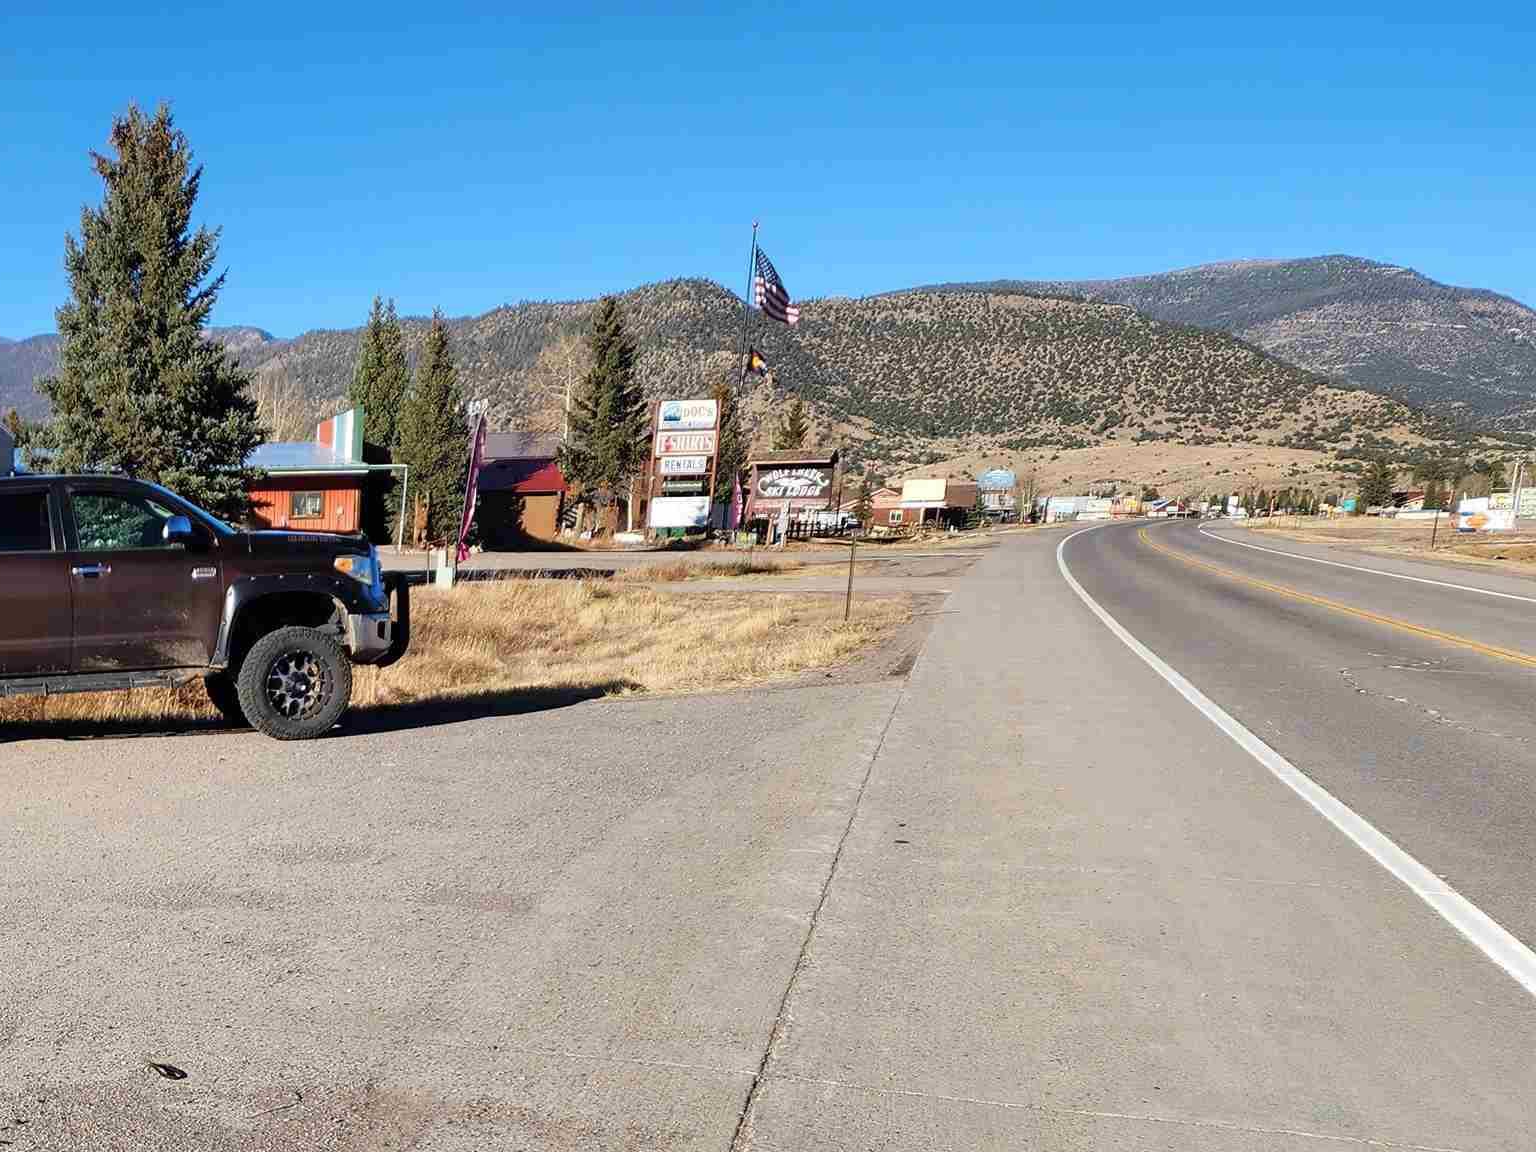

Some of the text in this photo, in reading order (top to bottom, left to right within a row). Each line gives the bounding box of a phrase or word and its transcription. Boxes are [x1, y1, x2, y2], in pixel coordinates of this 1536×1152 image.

[664, 458, 705, 470] RENTALS
[765, 468, 790, 481] WOLF
[766, 485, 823, 497] SKI LODGE
